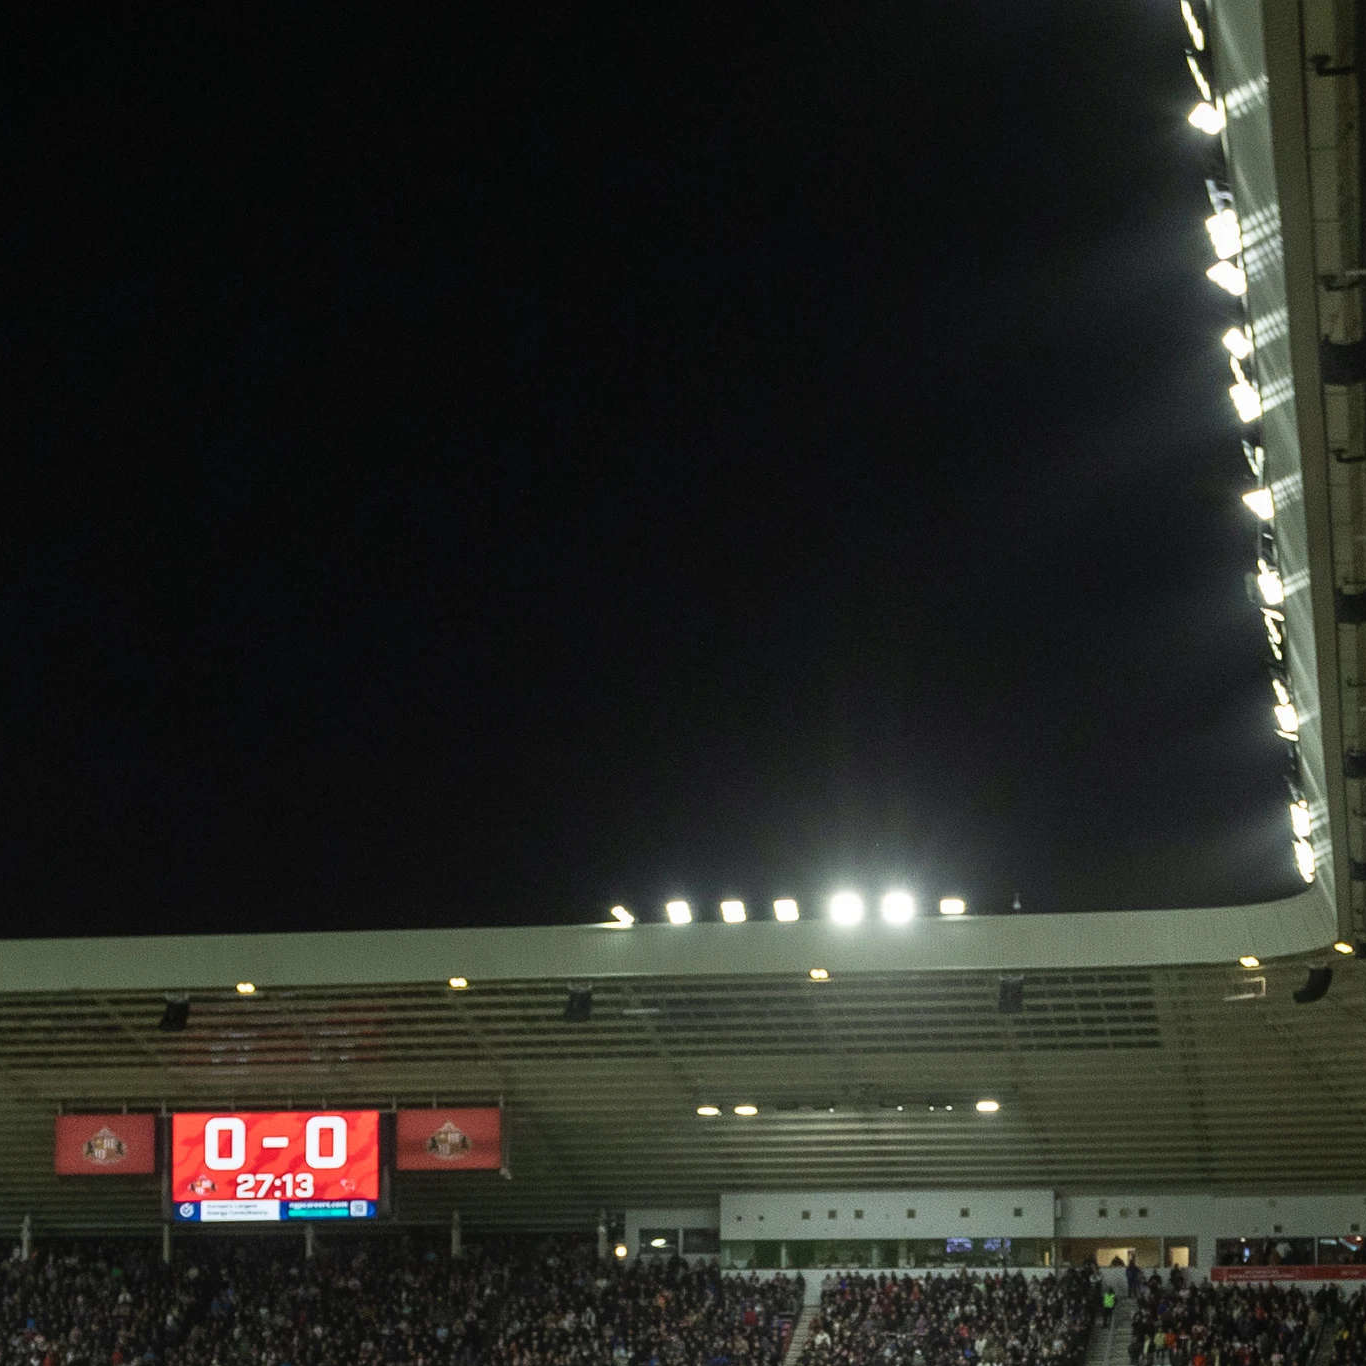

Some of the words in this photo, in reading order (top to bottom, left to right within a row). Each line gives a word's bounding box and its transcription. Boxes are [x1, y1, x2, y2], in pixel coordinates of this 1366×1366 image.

[204, 1117, 246, 1170] 0
[305, 1116, 347, 1170] 0
[236, 1173, 314, 1199] 27:13
